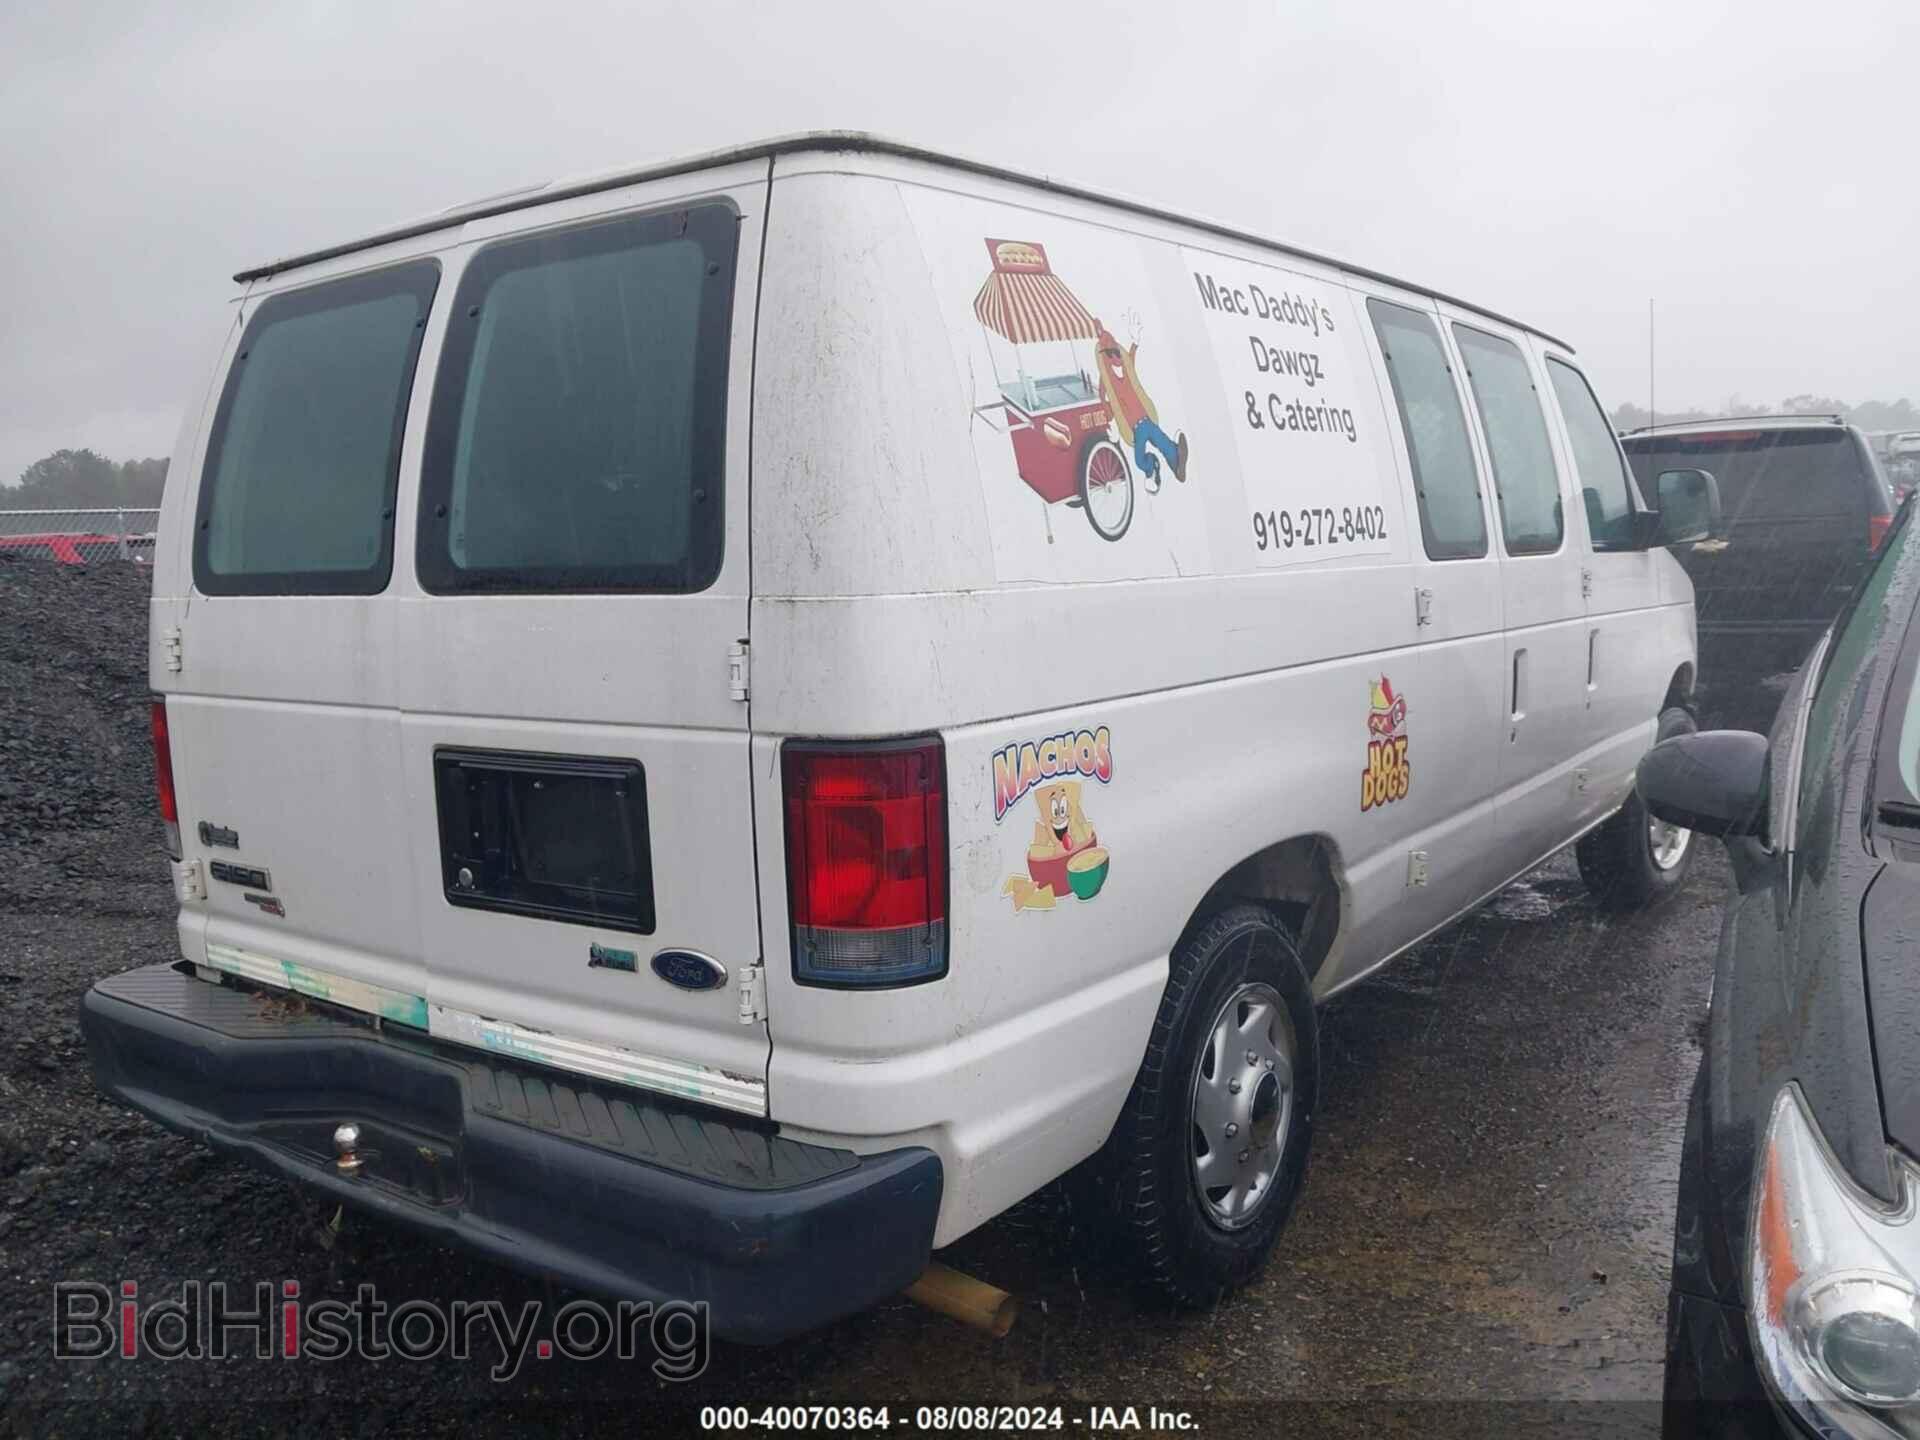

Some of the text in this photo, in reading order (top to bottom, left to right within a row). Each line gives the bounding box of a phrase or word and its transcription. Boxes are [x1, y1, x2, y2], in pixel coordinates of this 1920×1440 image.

[1194, 272, 1335, 337] Mac Daddy's
[1249, 336, 1324, 387] Dawgz
[1245, 391, 1357, 442] & Catering
[1253, 506, 1387, 551] 919-272-8402
[993, 726, 1112, 821] NACHOS
[1368, 734, 1408, 777] HOT
[1361, 759, 1410, 812] DOGS
[668, 957, 704, 983] Ford
